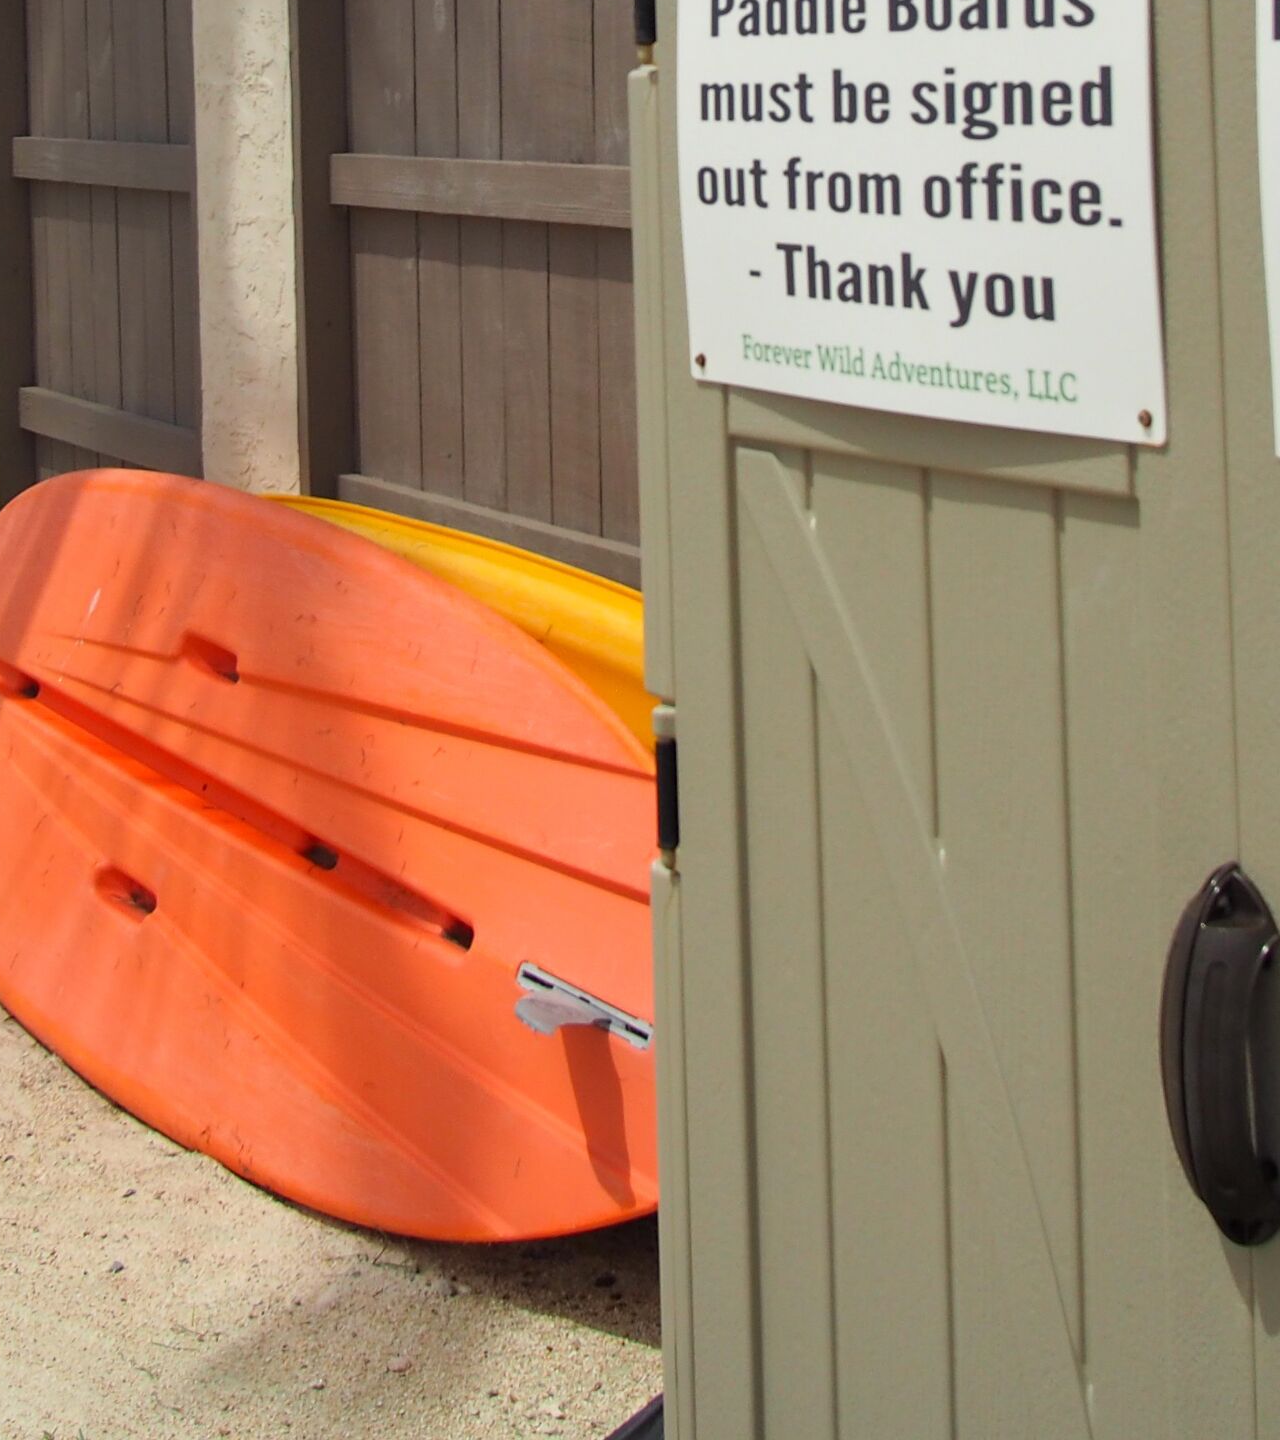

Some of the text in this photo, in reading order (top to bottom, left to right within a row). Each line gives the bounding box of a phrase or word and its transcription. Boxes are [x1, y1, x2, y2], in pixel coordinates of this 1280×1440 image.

[701, 66, 1112, 140] must be signed
[698, 157, 1122, 227] out from office.
[776, 243, 929, 310] Thank
[949, 271, 1055, 328] you
[742, 334, 1077, 402] Forever Wild Adventures, LLC
